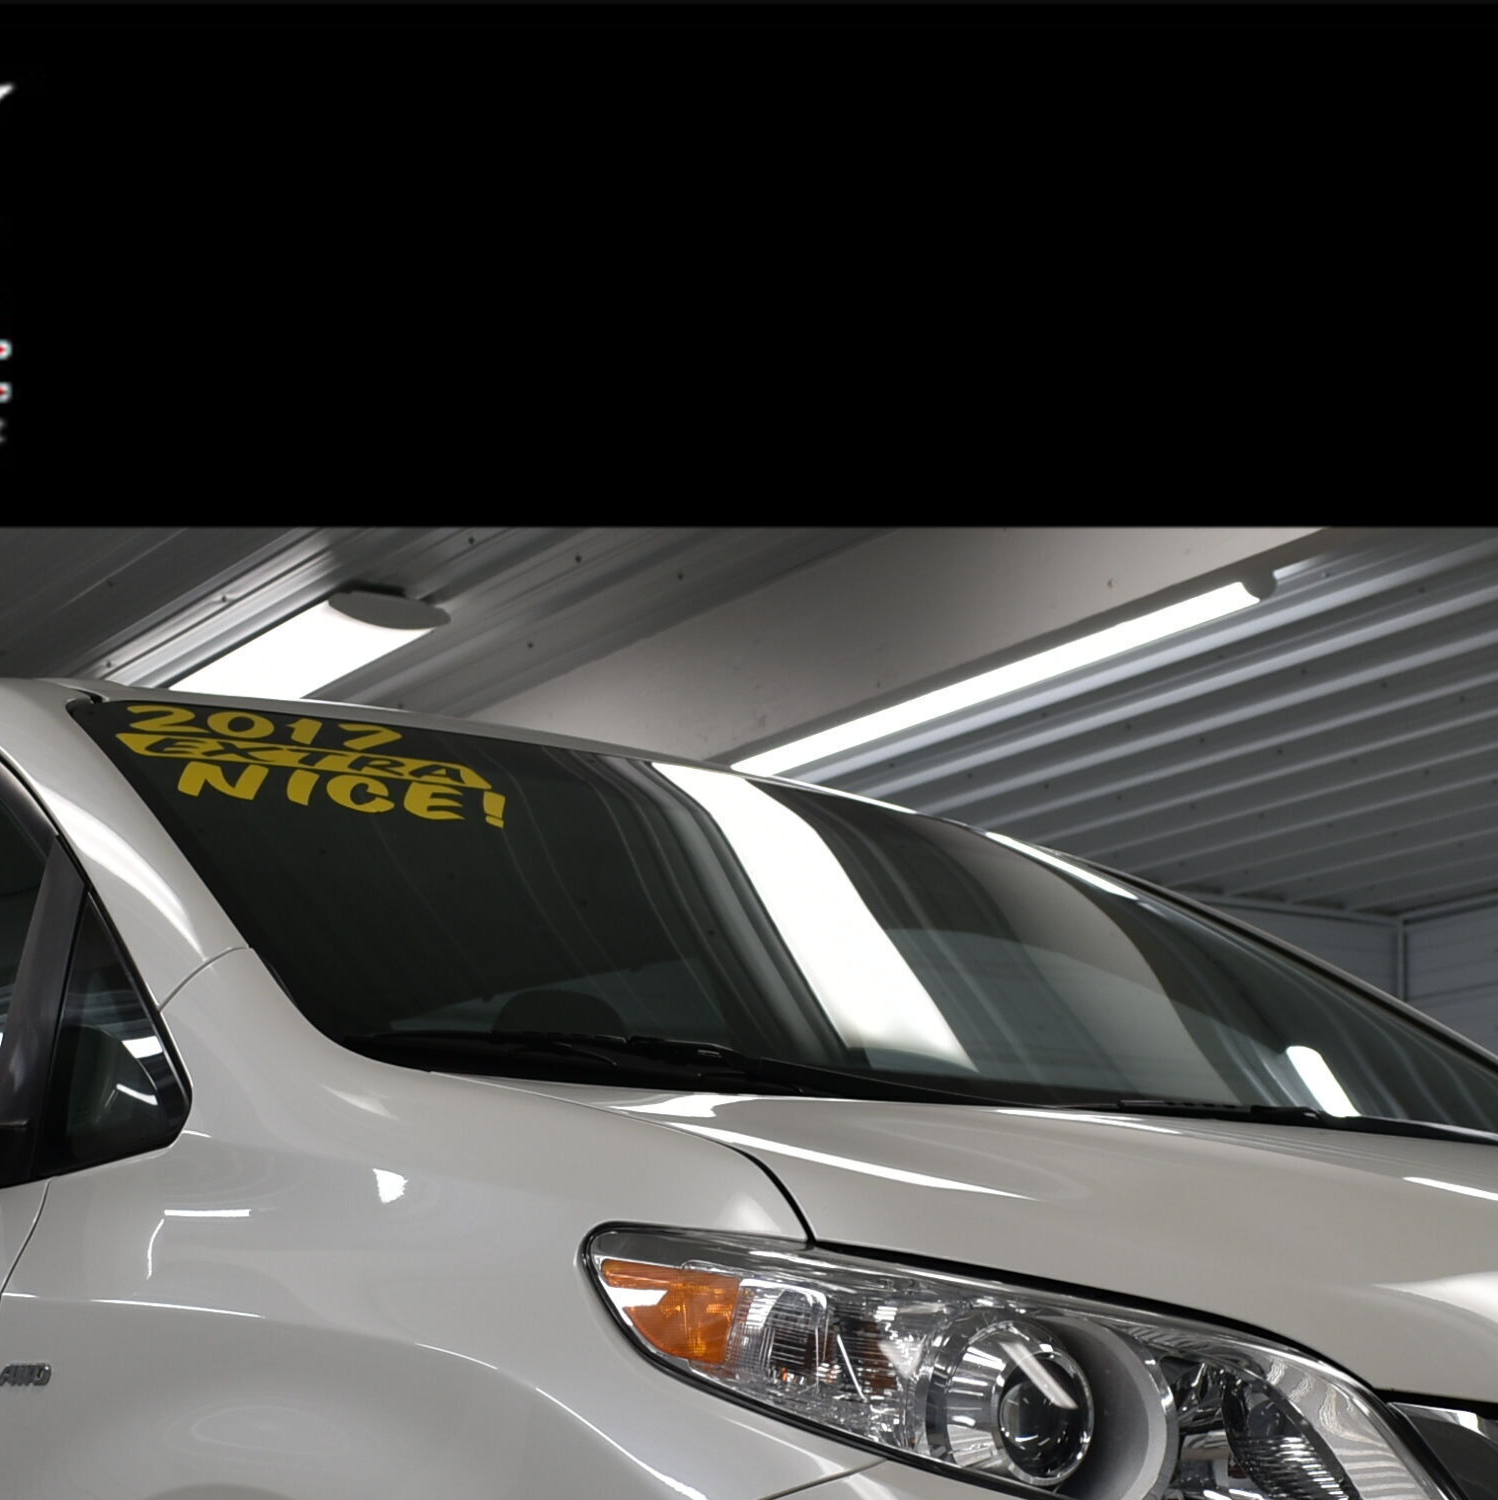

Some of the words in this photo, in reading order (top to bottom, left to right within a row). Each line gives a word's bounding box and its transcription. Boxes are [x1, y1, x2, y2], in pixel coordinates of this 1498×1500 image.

[127, 705, 403, 751] 2017
[144, 737, 466, 785] EXTRA
[177, 761, 506, 829] NICE!
